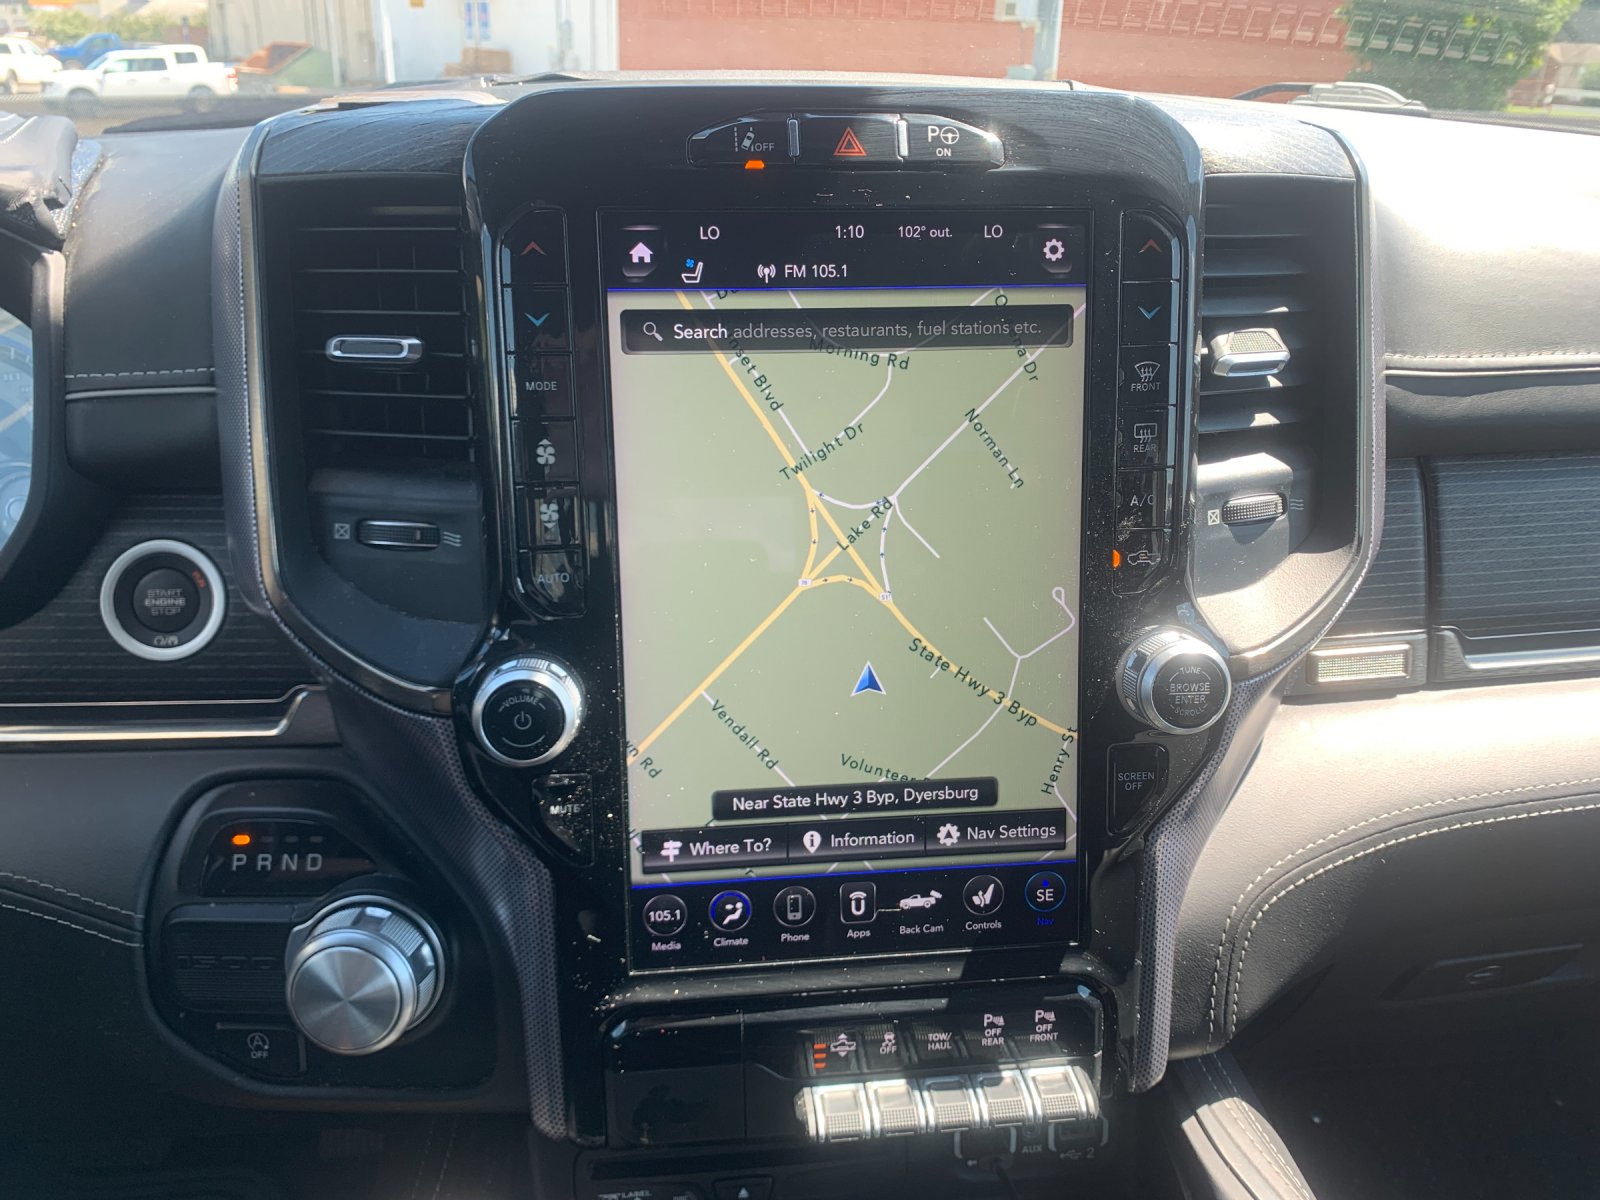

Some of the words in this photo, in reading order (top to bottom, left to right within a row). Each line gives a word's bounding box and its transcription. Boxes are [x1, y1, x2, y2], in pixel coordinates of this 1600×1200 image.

[755, 142, 775, 152] OFF
[936, 147, 951, 157] ON
[700, 225, 720, 240] LO
[835, 224, 865, 239] 1:10
[898, 225, 926, 238] 102°
[929, 226, 953, 238] out.
[984, 224, 1003, 238] LO
[784, 264, 806, 278] FM
[811, 264, 848, 278] 105.1
[673, 323, 728, 339] Search
[733, 322, 817, 340] addresses,
[822, 323, 912, 339] restaurants,
[916, 320, 946, 336] fuel
[951, 320, 1010, 335] stations
[1014, 321, 1042, 334] etc.
[809, 337, 880, 366] Morning
[887, 353, 910, 370] Rd
[1023, 361, 1039, 381] Dr
[525, 381, 558, 391] MODE
[1130, 382, 1161, 392] FRONT
[753, 374, 784, 411] Blvd
[779, 436, 844, 481] Twilight
[843, 421, 864, 442] Dr
[964, 407, 1009, 468] Norman
[1007, 466, 1025, 488] Ln
[1133, 444, 1157, 453] REAR
[836, 519, 871, 551] Lake
[870, 496, 894, 520] Rd
[537, 572, 570, 584] AUTO
[147, 588, 183, 598] START
[144, 597, 187, 607] ENGINE
[151, 606, 182, 616] STOP
[1179, 666, 1201, 676] TUNE
[908, 637, 951, 672] State
[954, 666, 990, 697] Hwy
[993, 691, 1006, 705] 3
[1007, 700, 1038, 727] Byp
[1169, 682, 1211, 693] BROWSE
[502, 695, 539, 708] VOLUME
[1175, 694, 1207, 705] ENTER
[711, 699, 759, 750] Vendall
[757, 748, 780, 771] Rd
[1041, 748, 1070, 795] Henry
[1061, 726, 1078, 744] St
[640, 757, 663, 778] Rd
[1117, 771, 1155, 781] SCREEN
[1124, 782, 1143, 791] OFF
[732, 796, 768, 811] Near
[773, 794, 811, 809] State
[815, 792, 848, 808] Hwy
[853, 791, 863, 804] 3
[866, 789, 899, 806] Byp,
[904, 786, 979, 803] Dyersburg
[549, 804, 581, 815] MUTE
[967, 827, 995, 840] Nav
[999, 823, 1057, 841] Settings
[831, 830, 915, 848] Information
[689, 840, 740, 857] Where
[743, 838, 772, 852] To?
[1036, 889, 1054, 902] SE
[649, 909, 681, 922] 105.1
[899, 924, 921, 934] Back
[923, 924, 944, 933] Cam
[965, 920, 1002, 930] Controls
[781, 933, 810, 942] Phone
[846, 929, 871, 939] Apps
[651, 941, 682, 951] Media
[713, 936, 749, 947] Climate
[984, 1028, 1002, 1037] OFF
[1035, 1023, 1053, 1033] OFF
[928, 1032, 953, 1043] TOW/
[981, 1037, 1005, 1046] REAR
[1029, 1032, 1058, 1042] FRONT
[879, 1045, 897, 1055] OFF
[928, 1041, 952, 1051] HAUL
[250, 1050, 269, 1059] OFF
